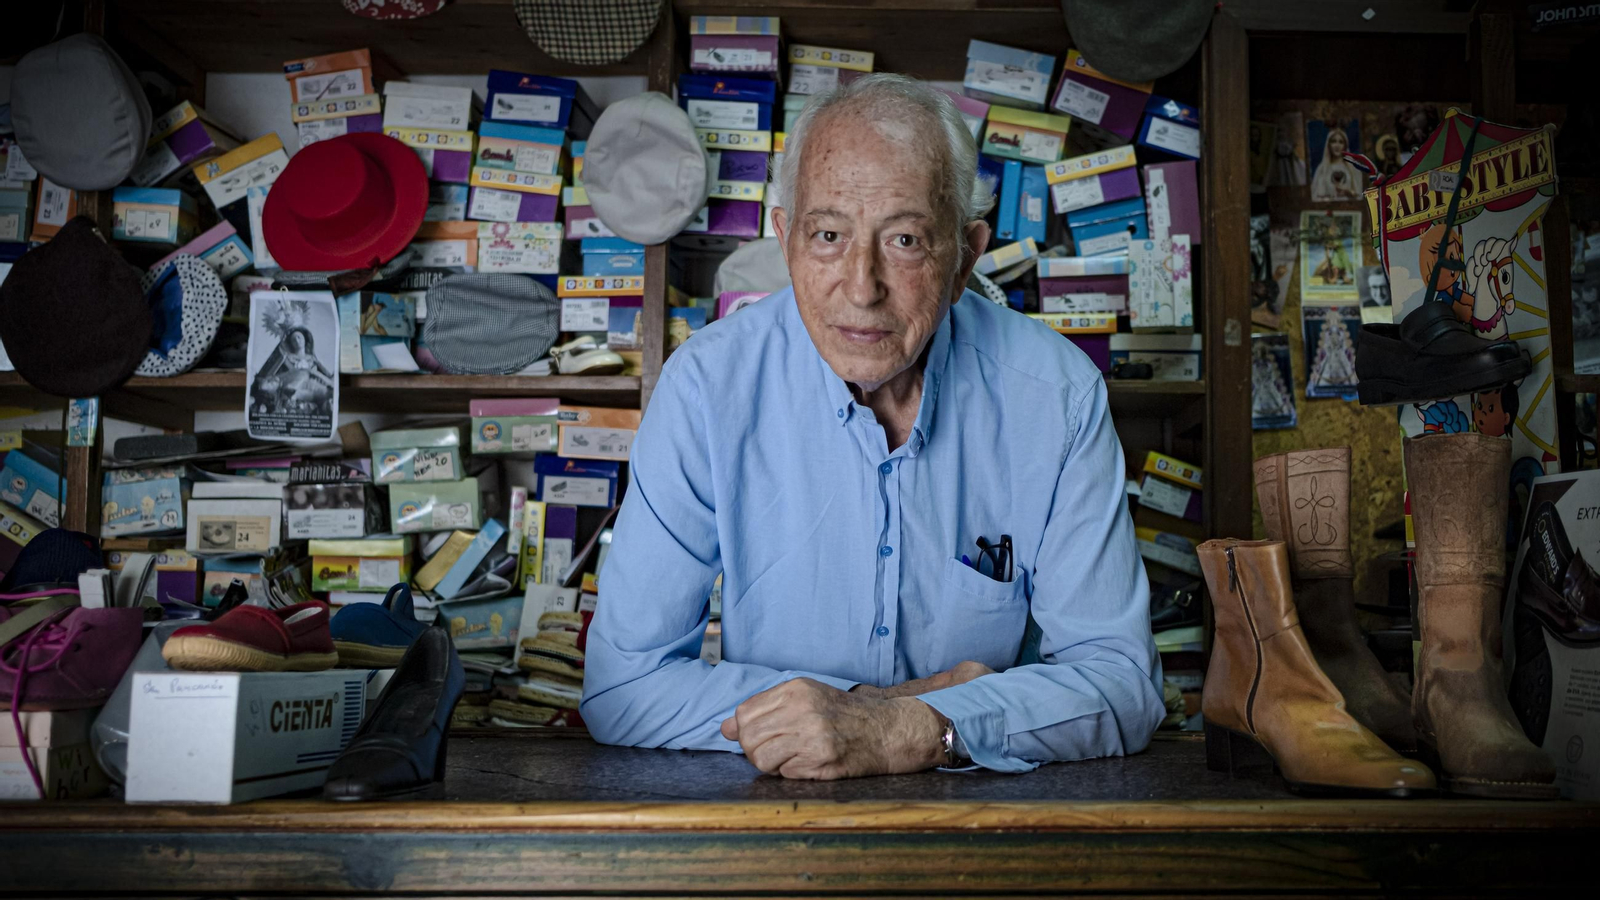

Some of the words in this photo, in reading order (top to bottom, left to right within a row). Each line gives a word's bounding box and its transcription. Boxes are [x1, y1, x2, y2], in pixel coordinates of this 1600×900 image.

[1536, 6, 1576, 23] JOHN
[347, 82, 356, 92] 22
[794, 82, 810, 92] 22
[450, 117, 461, 125] 22
[1459, 137, 1549, 201] STYLE
[452, 256, 462, 264] 24
[618, 445, 628, 453] 21
[291, 464, 342, 482] marianitas
[237, 532, 250, 543] 24
[557, 596, 565, 606] 23
[270, 699, 334, 733] CIENTA
